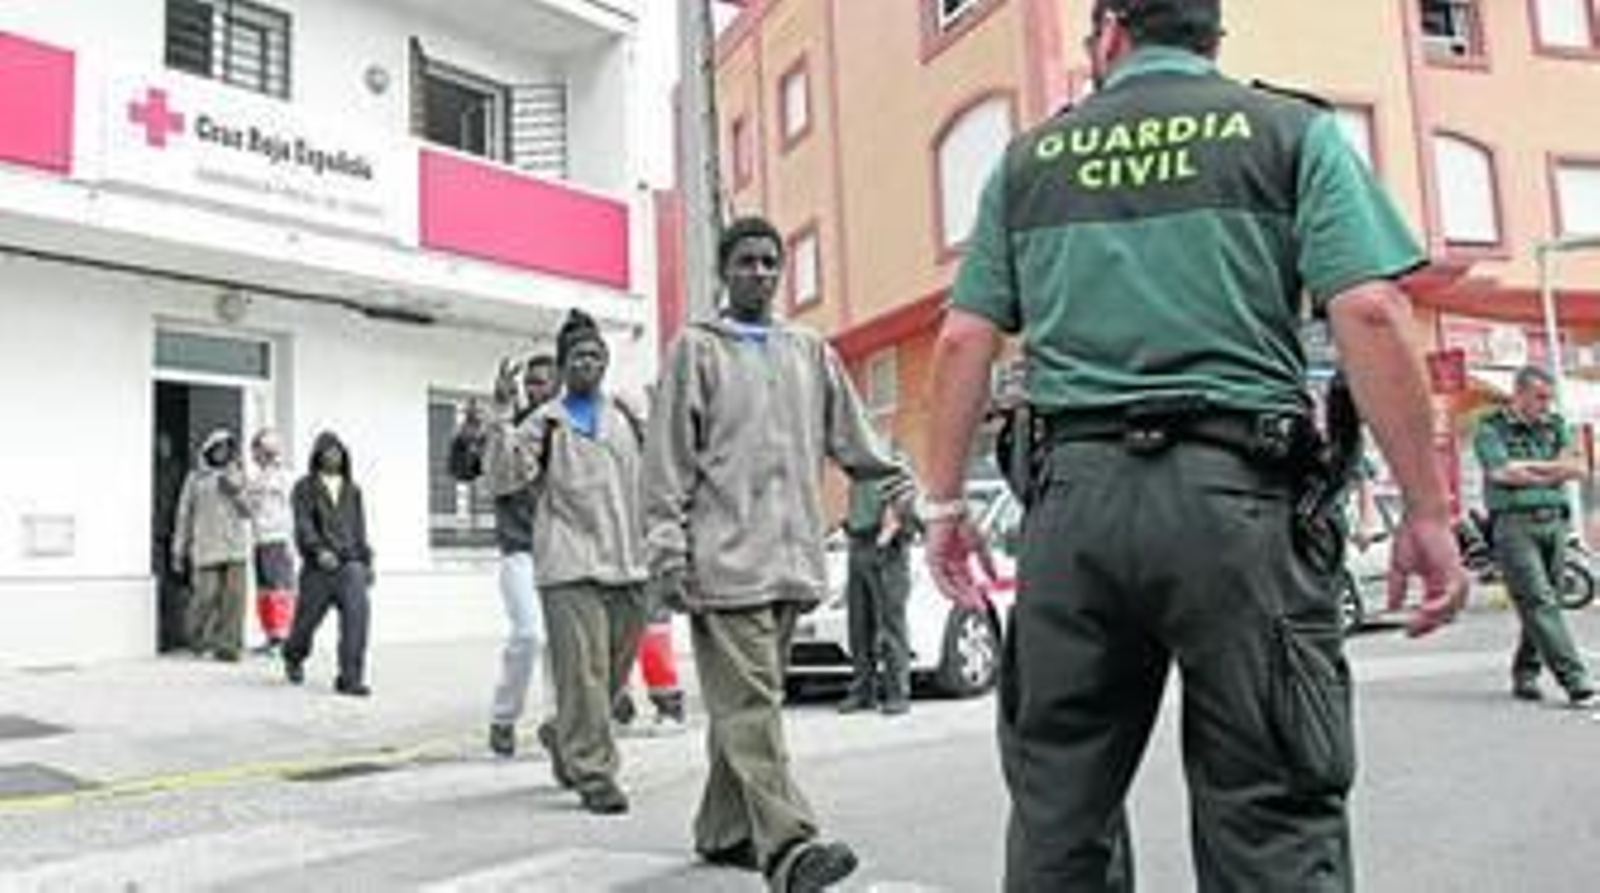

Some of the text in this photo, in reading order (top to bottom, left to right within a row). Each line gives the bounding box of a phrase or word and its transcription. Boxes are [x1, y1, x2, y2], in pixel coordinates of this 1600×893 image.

[194, 114, 243, 150] Cruz
[248, 126, 291, 164] Roja
[1037, 112, 1252, 158] GUARDIA
[1077, 150, 1198, 188] CIVIL
